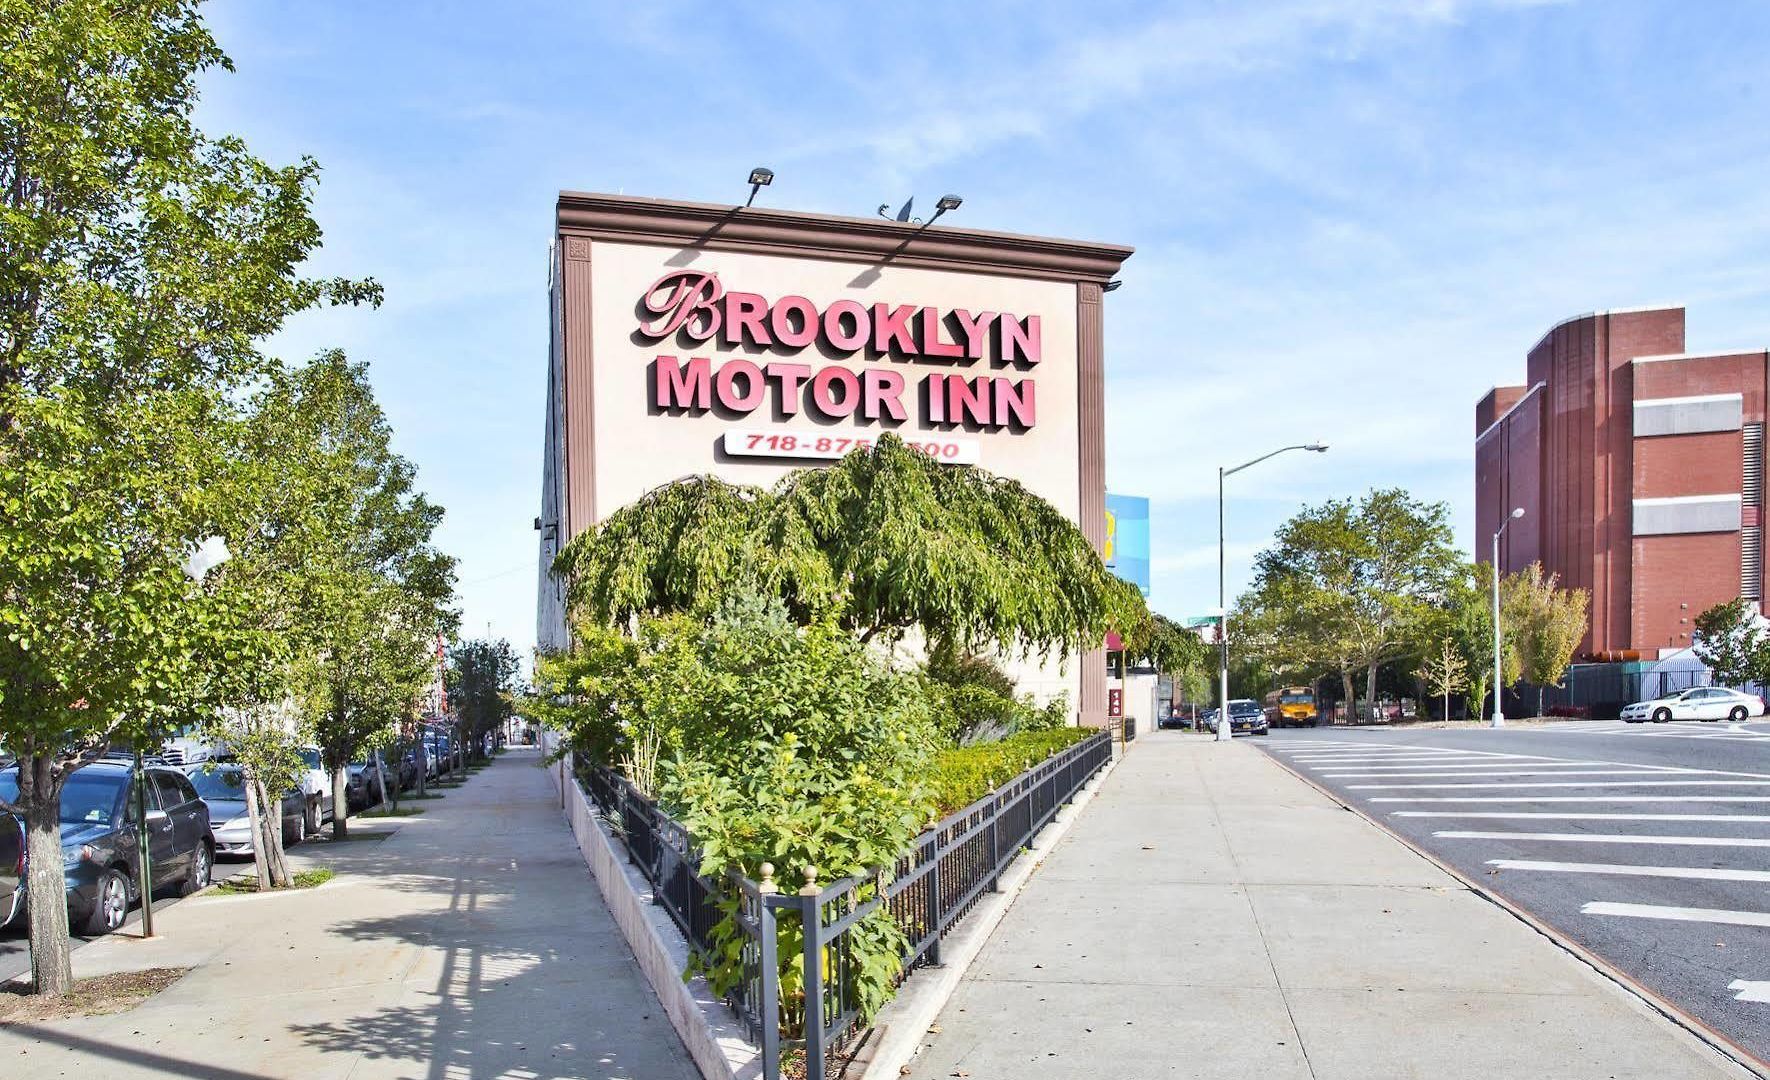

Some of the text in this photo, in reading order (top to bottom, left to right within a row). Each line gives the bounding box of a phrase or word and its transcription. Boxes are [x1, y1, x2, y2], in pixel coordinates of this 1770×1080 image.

[638, 269, 1041, 364] BROOKLYN
[655, 355, 1036, 428] MOTOR INN
